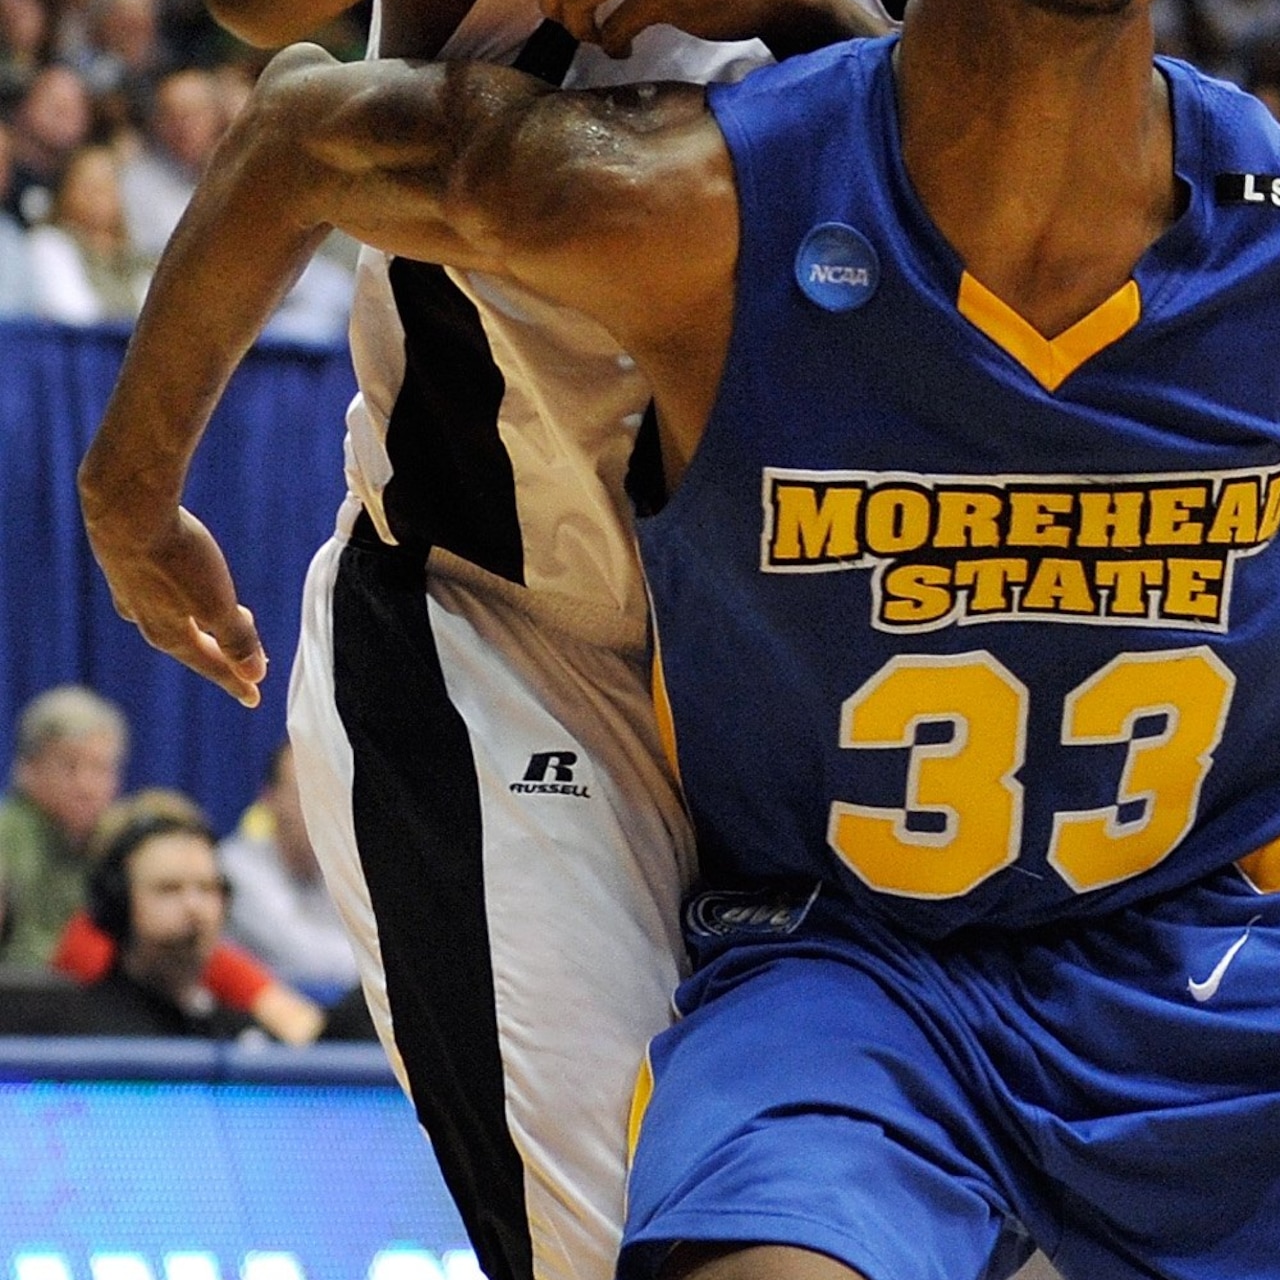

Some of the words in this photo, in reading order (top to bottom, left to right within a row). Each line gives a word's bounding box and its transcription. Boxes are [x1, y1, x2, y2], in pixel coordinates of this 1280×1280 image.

[809, 263, 869, 287] NCAA
[876, 552, 1228, 627] STATE
[509, 783, 591, 799] RUSSELL
[827, 646, 1237, 901] 33
